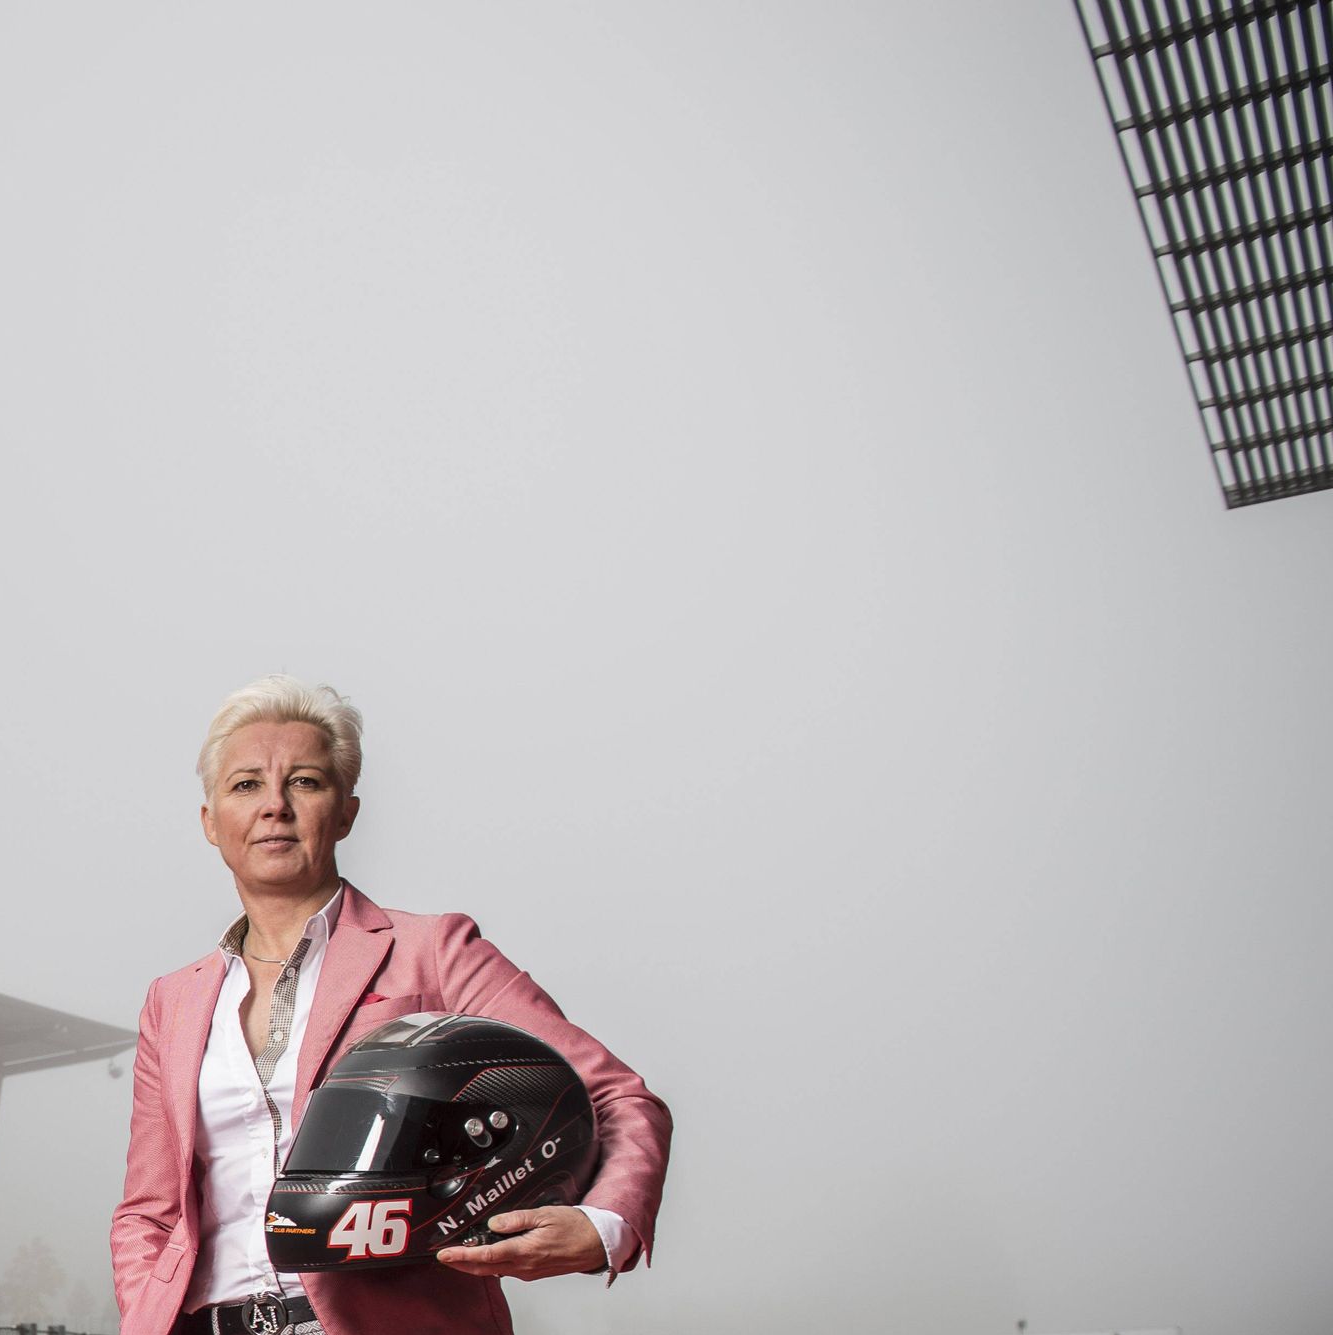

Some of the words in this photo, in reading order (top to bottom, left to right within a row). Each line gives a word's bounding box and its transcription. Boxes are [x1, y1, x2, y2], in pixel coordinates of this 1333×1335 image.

[327, 1198, 412, 1260] 46
[436, 1215, 465, 1236] N.
[465, 1158, 535, 1216] Maillet
